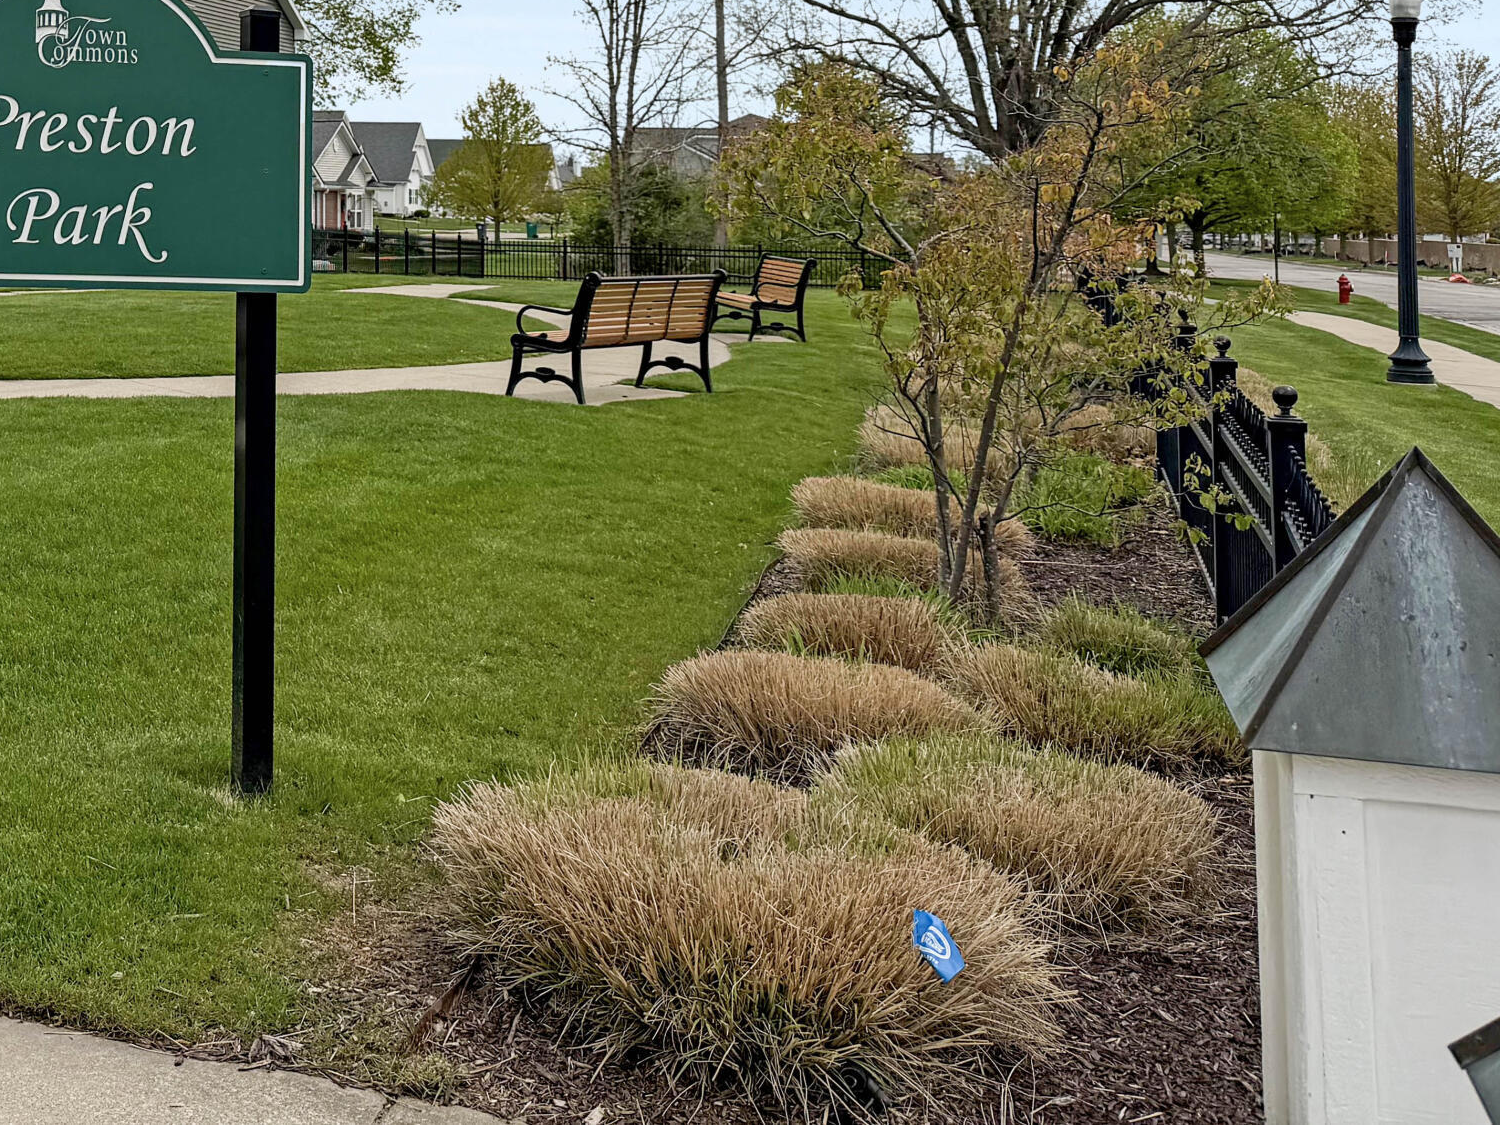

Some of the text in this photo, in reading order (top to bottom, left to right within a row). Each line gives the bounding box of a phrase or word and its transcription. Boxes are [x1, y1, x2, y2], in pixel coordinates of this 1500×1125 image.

[37, 33, 139, 68] Commons
[55, 16, 128, 61] Town
[6, 181, 168, 263] Park
